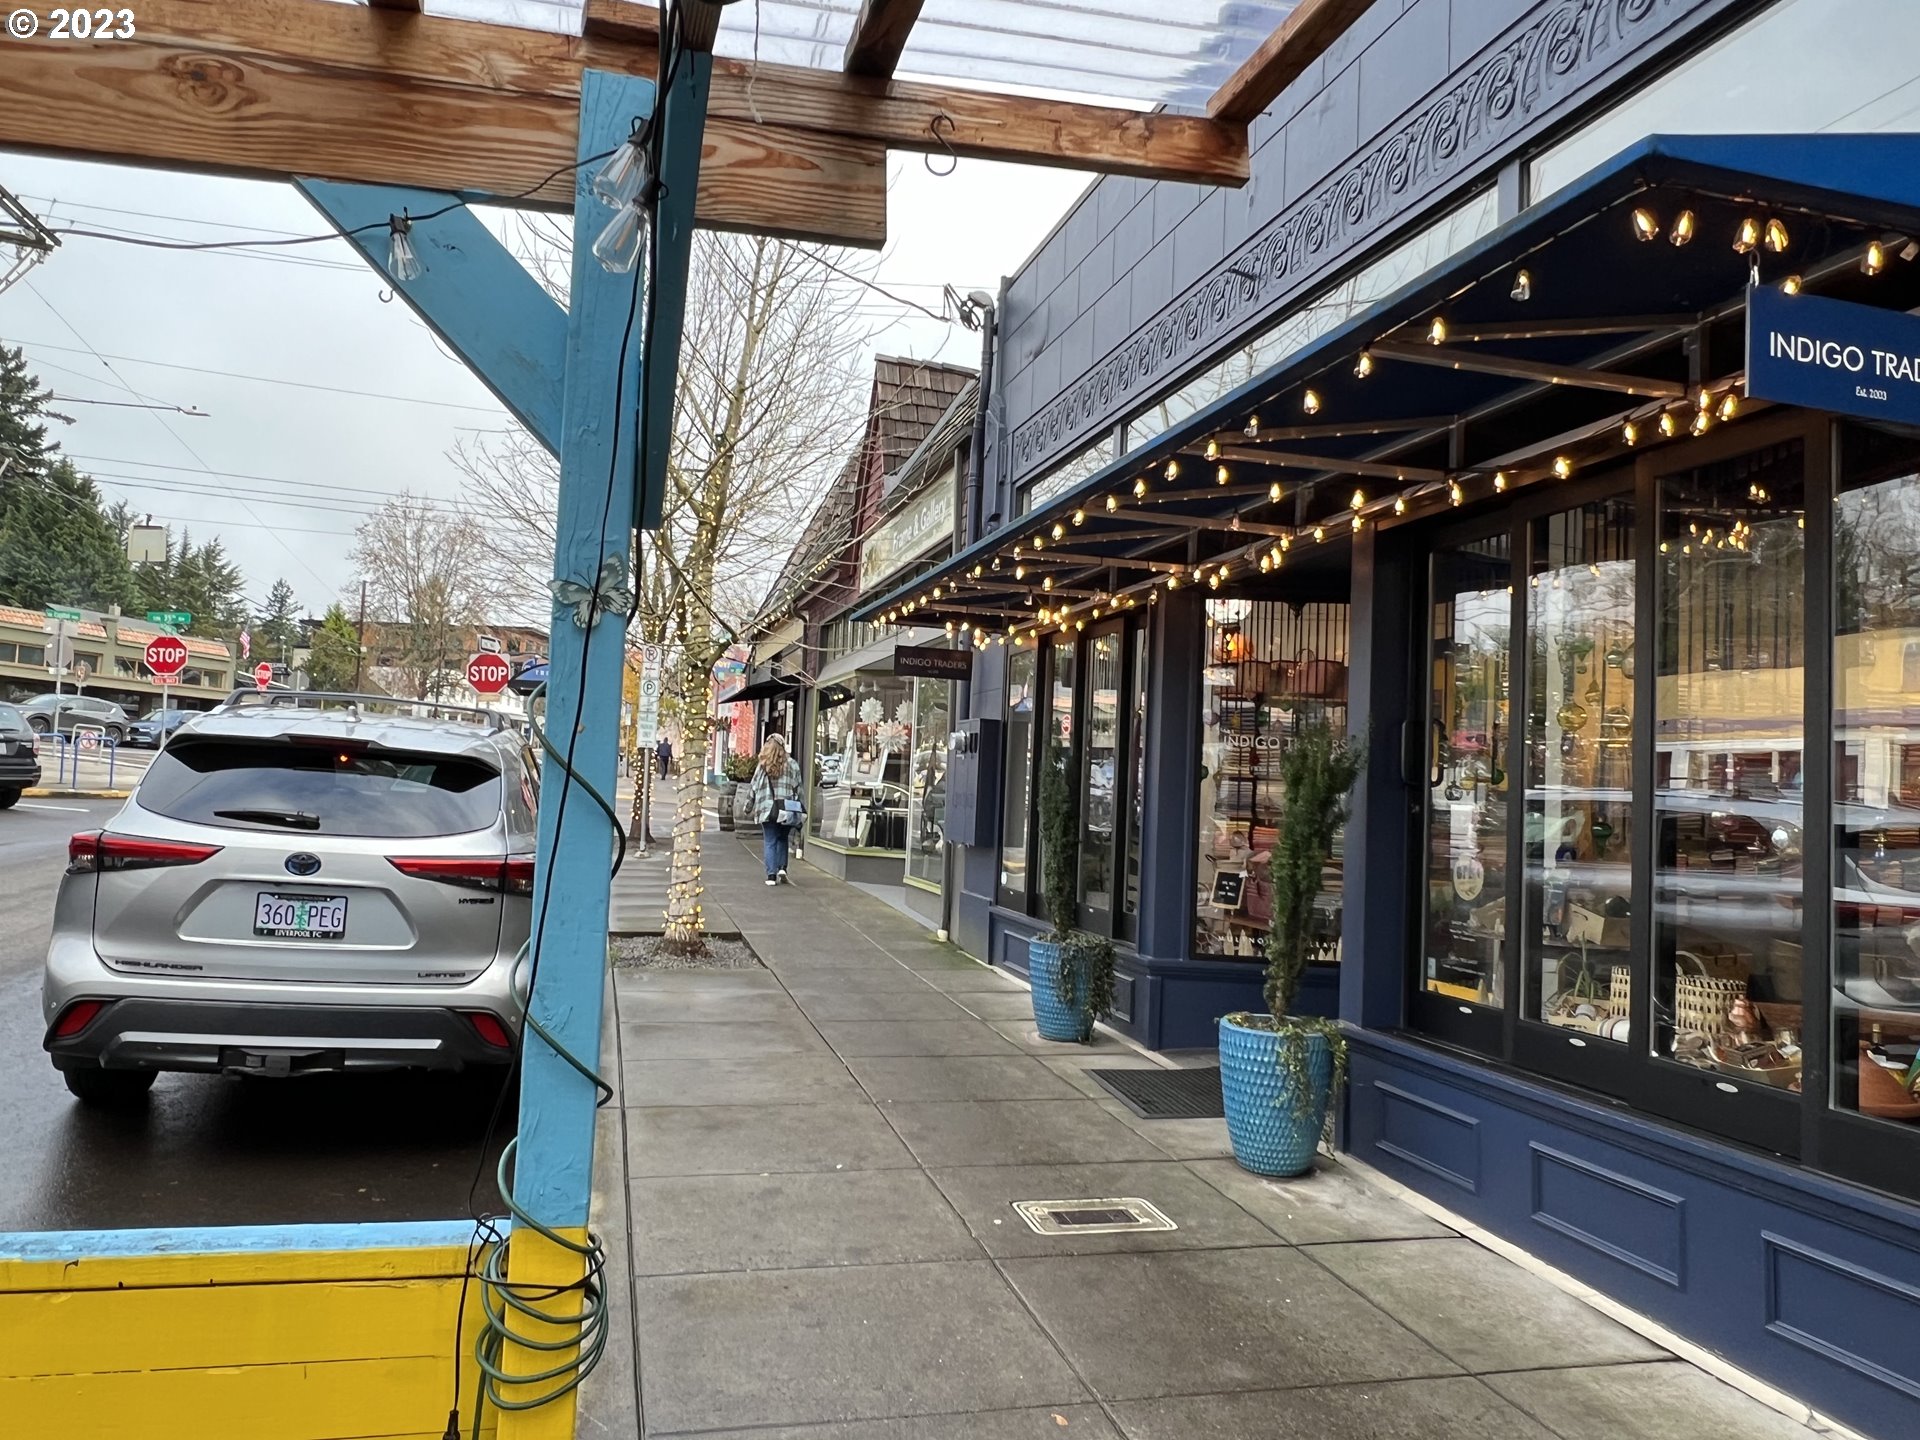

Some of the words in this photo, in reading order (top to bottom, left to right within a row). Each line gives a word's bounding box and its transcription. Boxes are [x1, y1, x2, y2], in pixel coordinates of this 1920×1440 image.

[1769, 331, 1865, 372] INDIGO
[1869, 388, 1888, 401] 2003
[912, 513, 920, 536] &
[920, 495, 947, 536] Gallery
[147, 647, 185, 663] STOP
[900, 656, 932, 668] INDIGO
[934, 658, 967, 670] TRADERS
[256, 669, 272, 680] STOP
[469, 665, 508, 682] STOP
[1223, 734, 1280, 749] INDIGO
[261, 903, 295, 926] 360
[307, 905, 342, 928] PEG
[275, 929, 311, 938] LIVERPOOL
